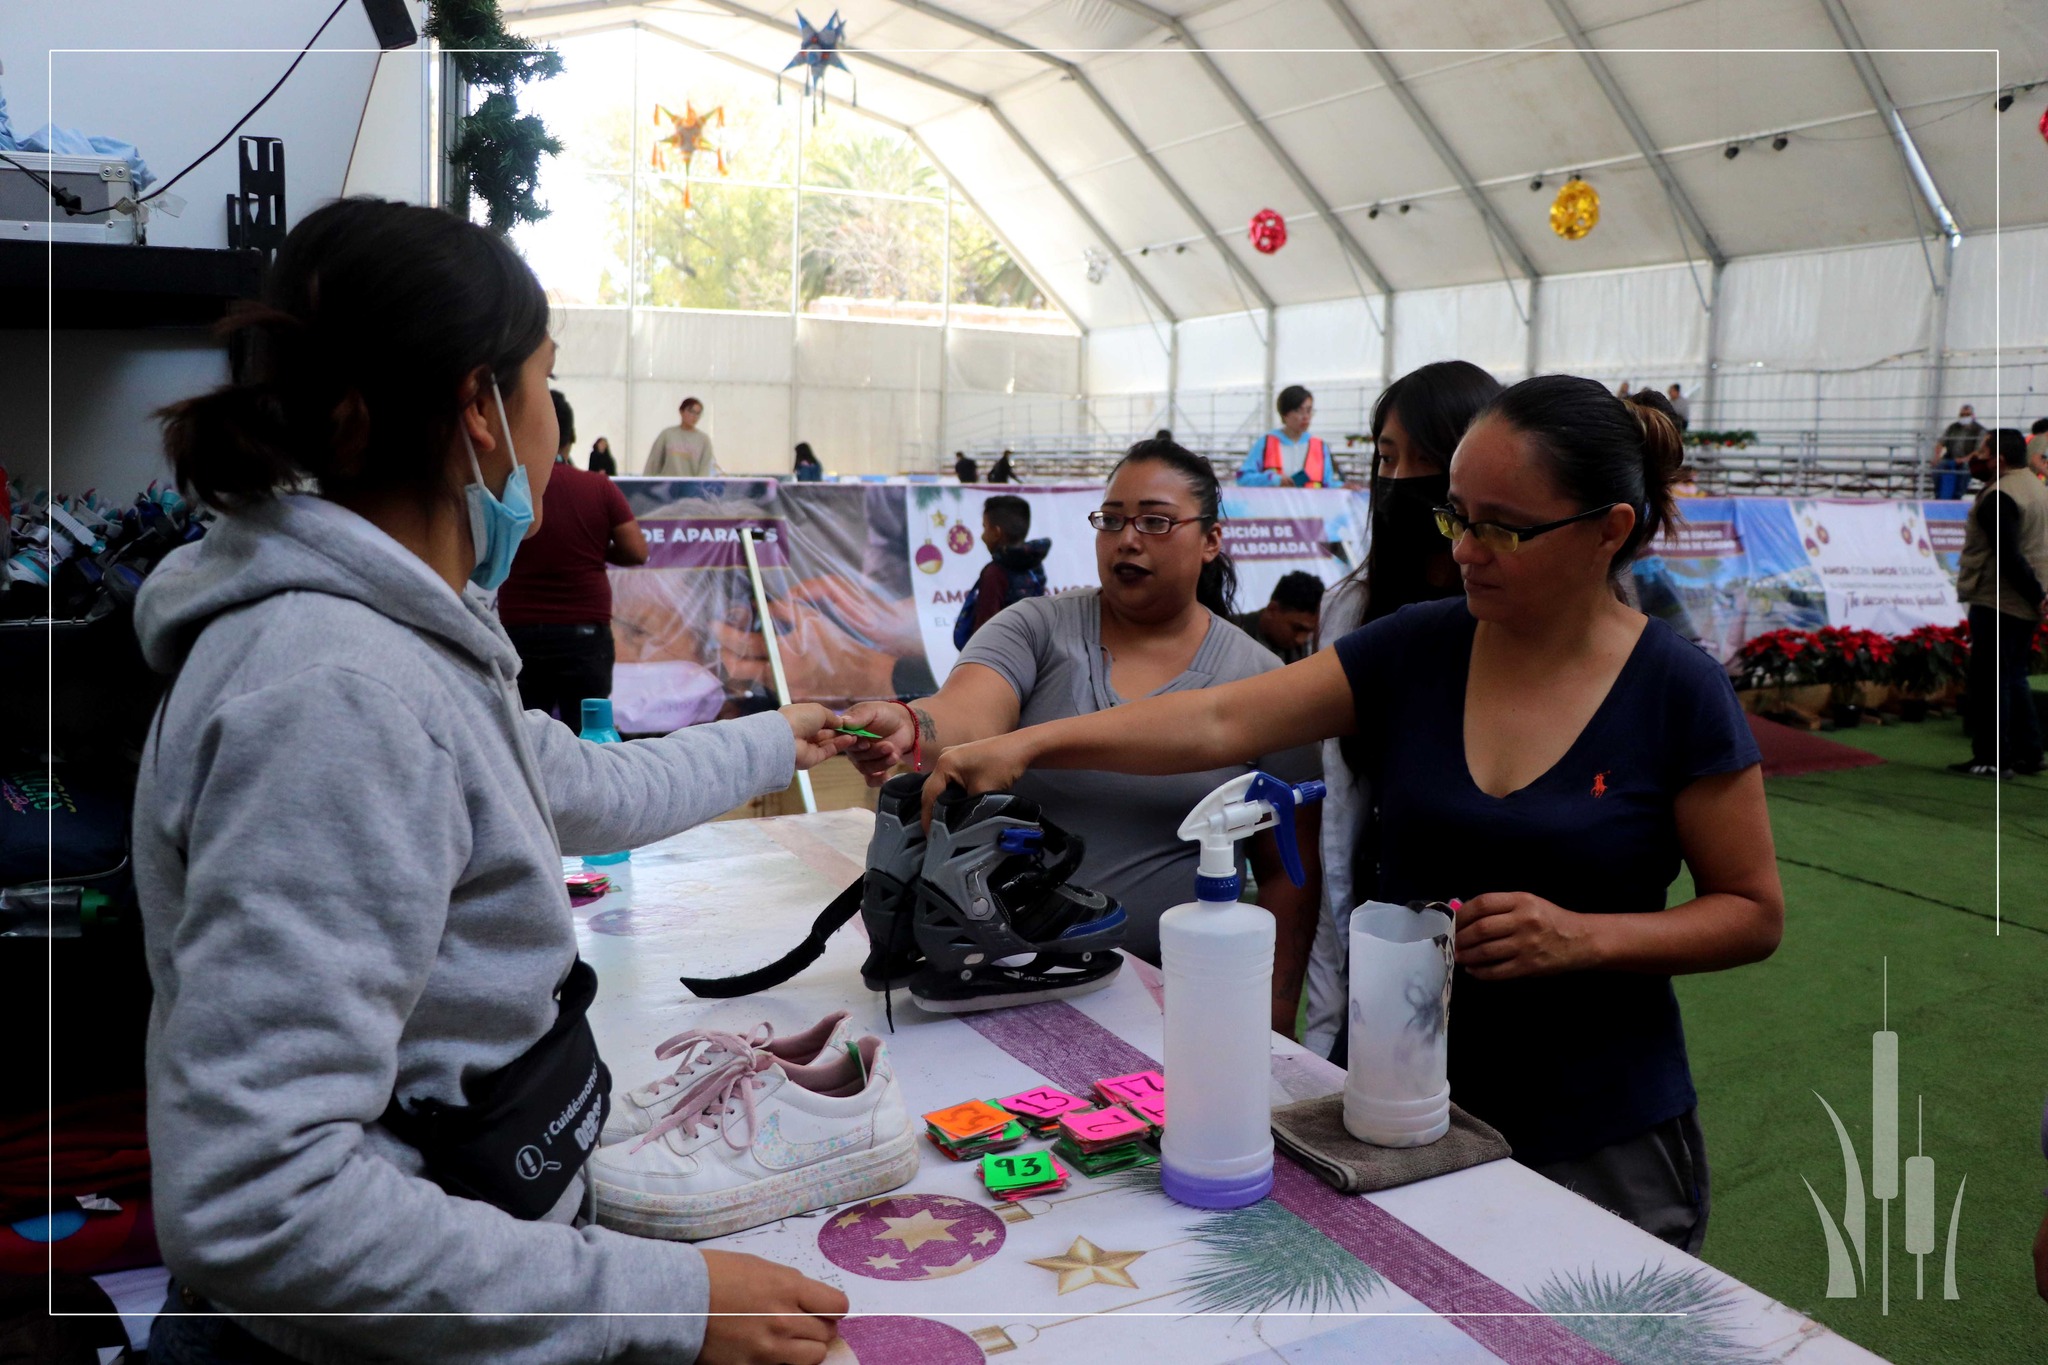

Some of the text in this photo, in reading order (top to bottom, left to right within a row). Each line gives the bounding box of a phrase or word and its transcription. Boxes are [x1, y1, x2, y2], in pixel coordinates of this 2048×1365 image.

[1273, 525, 1293, 538] DE
[1230, 541, 1310, 556] ALBORADA
[1015, 1091, 1070, 1115] 13
[994, 1157, 1042, 1178] 93
